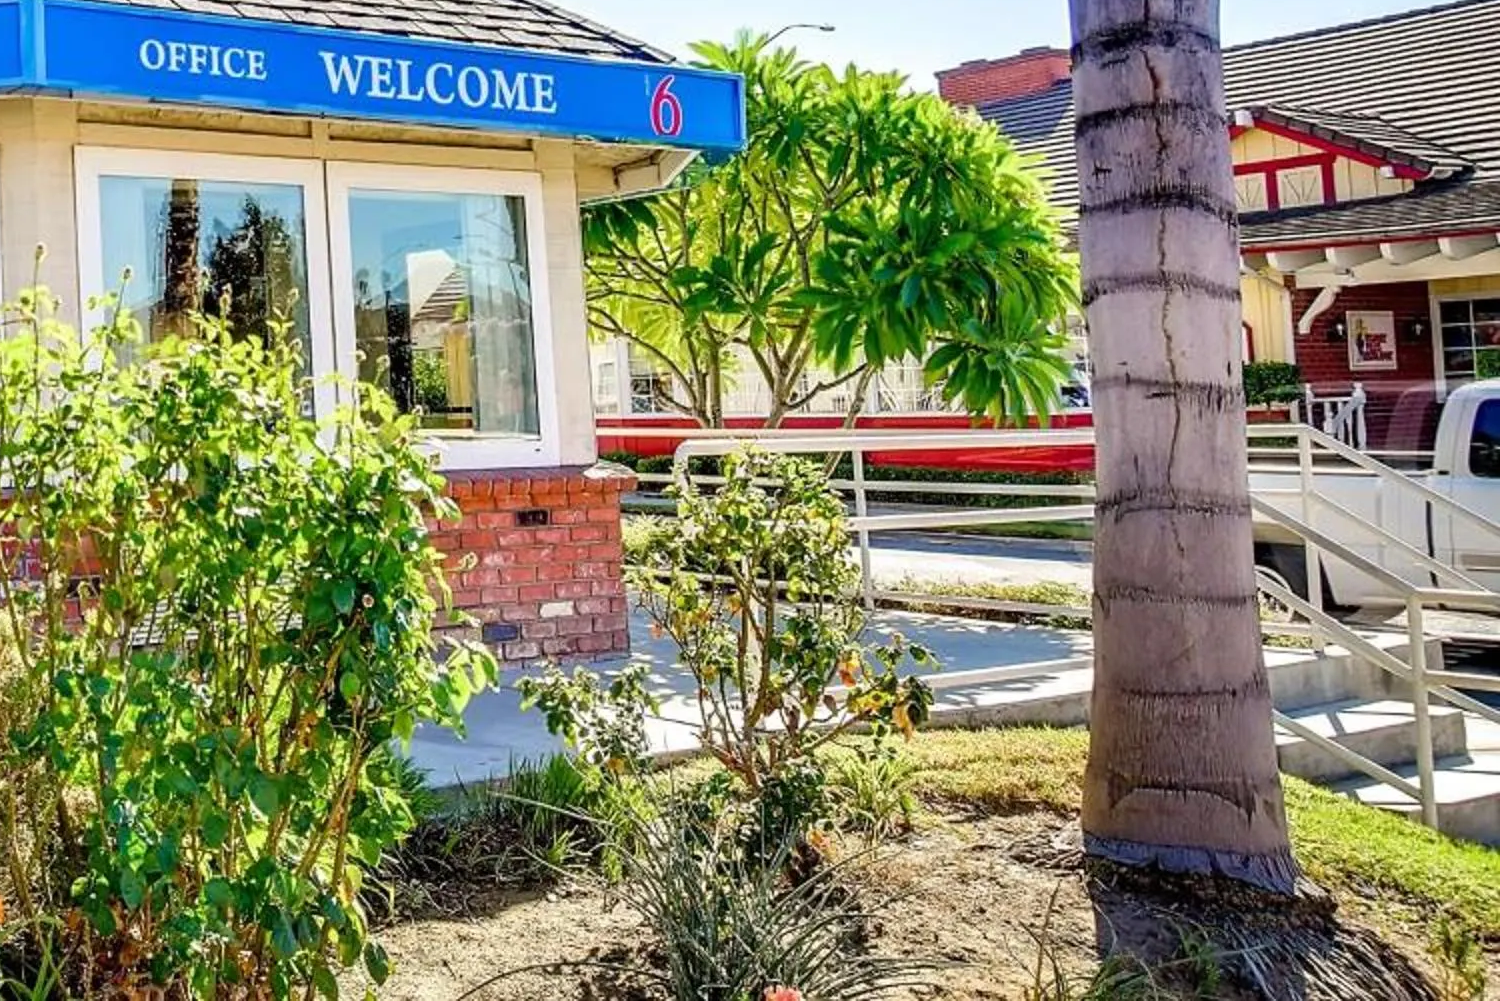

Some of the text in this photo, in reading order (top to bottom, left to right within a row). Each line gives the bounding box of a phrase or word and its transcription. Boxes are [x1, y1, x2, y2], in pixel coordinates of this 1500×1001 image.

[139, 39, 557, 114] OFFICE WELCOME
[650, 74, 683, 136] 6
